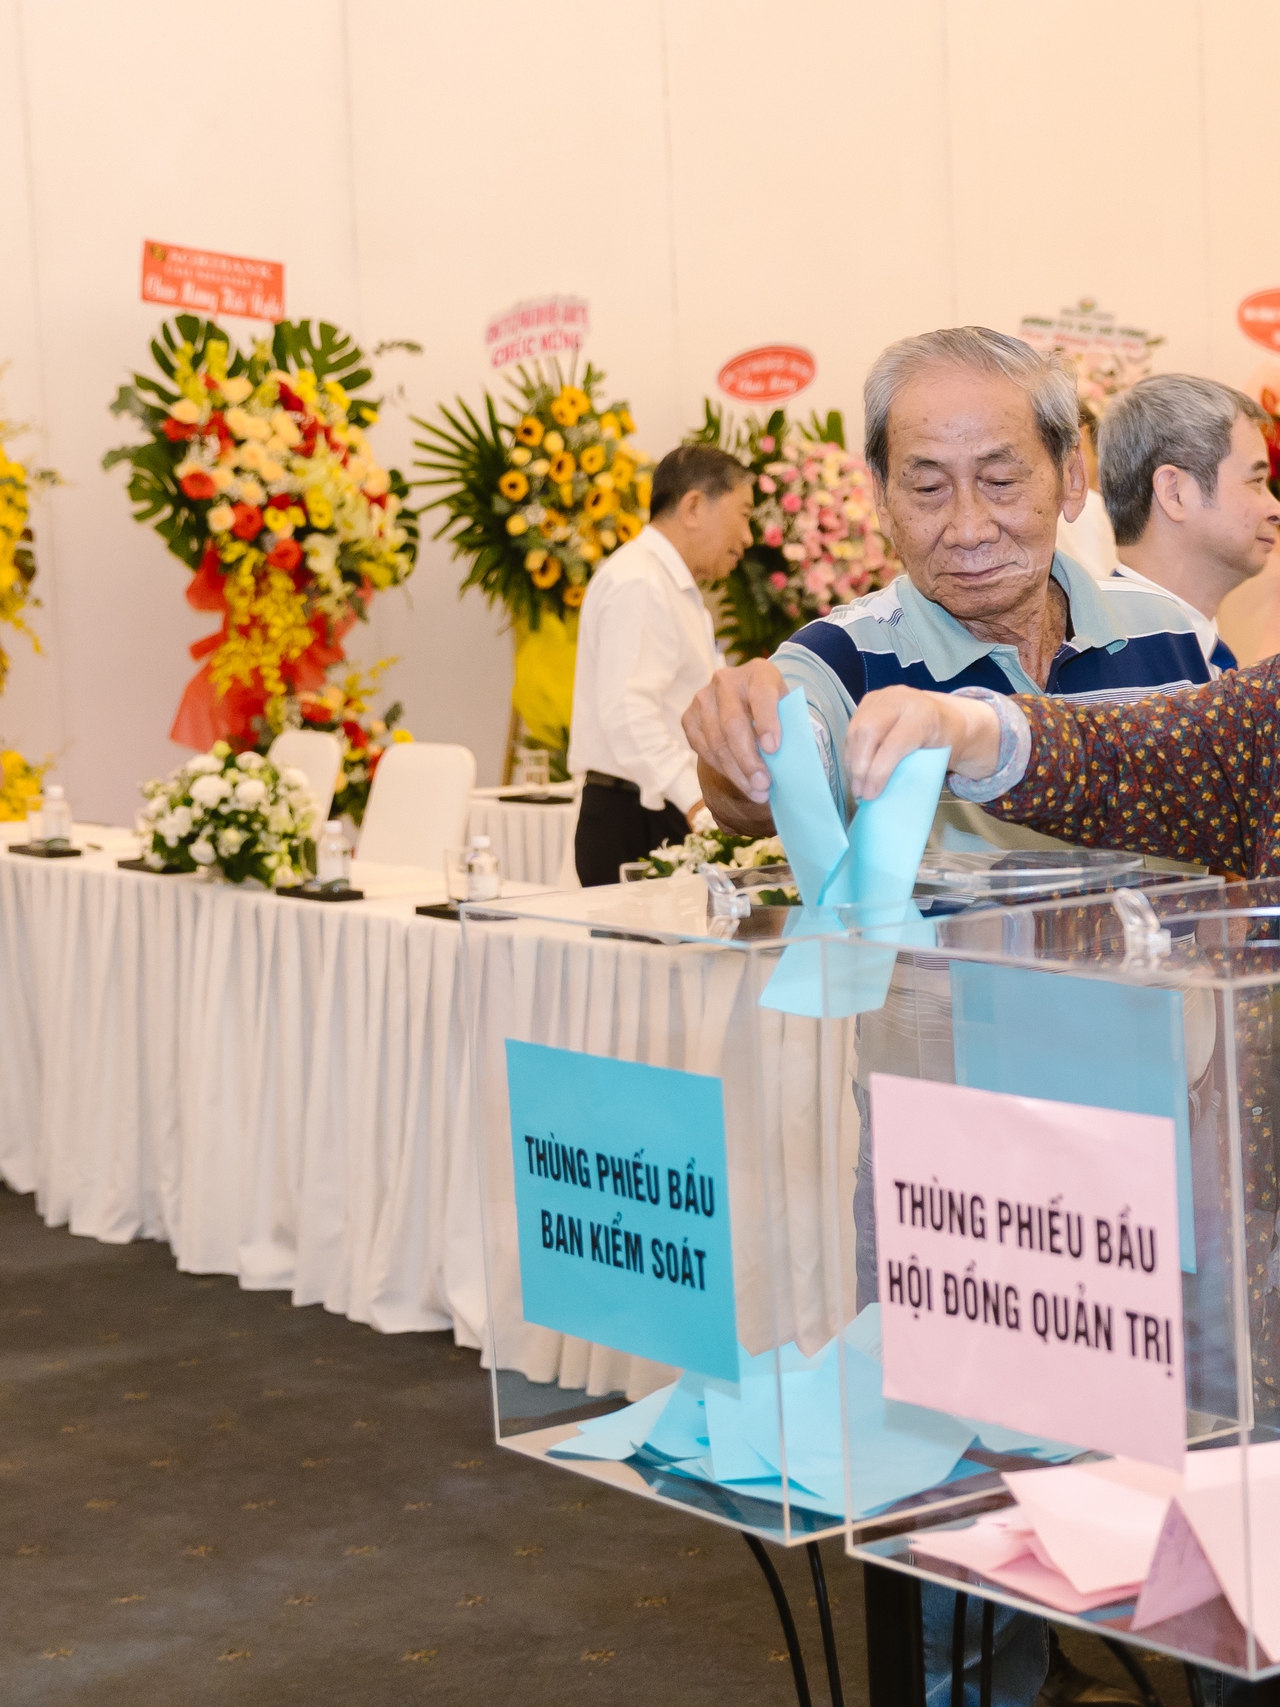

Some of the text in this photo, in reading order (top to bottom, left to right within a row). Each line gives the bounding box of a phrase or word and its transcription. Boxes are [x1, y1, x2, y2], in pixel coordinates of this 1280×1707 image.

[525, 1132, 715, 1218] THÙNG PHIẾU BẦU
[541, 1208, 707, 1291] BAN KIỂM SOÁT
[894, 1175, 1156, 1274] THÙNG PHIẾU BẦU
[888, 1254, 1173, 1378] HỘI ĐỒNG QUẢN TRỊ
